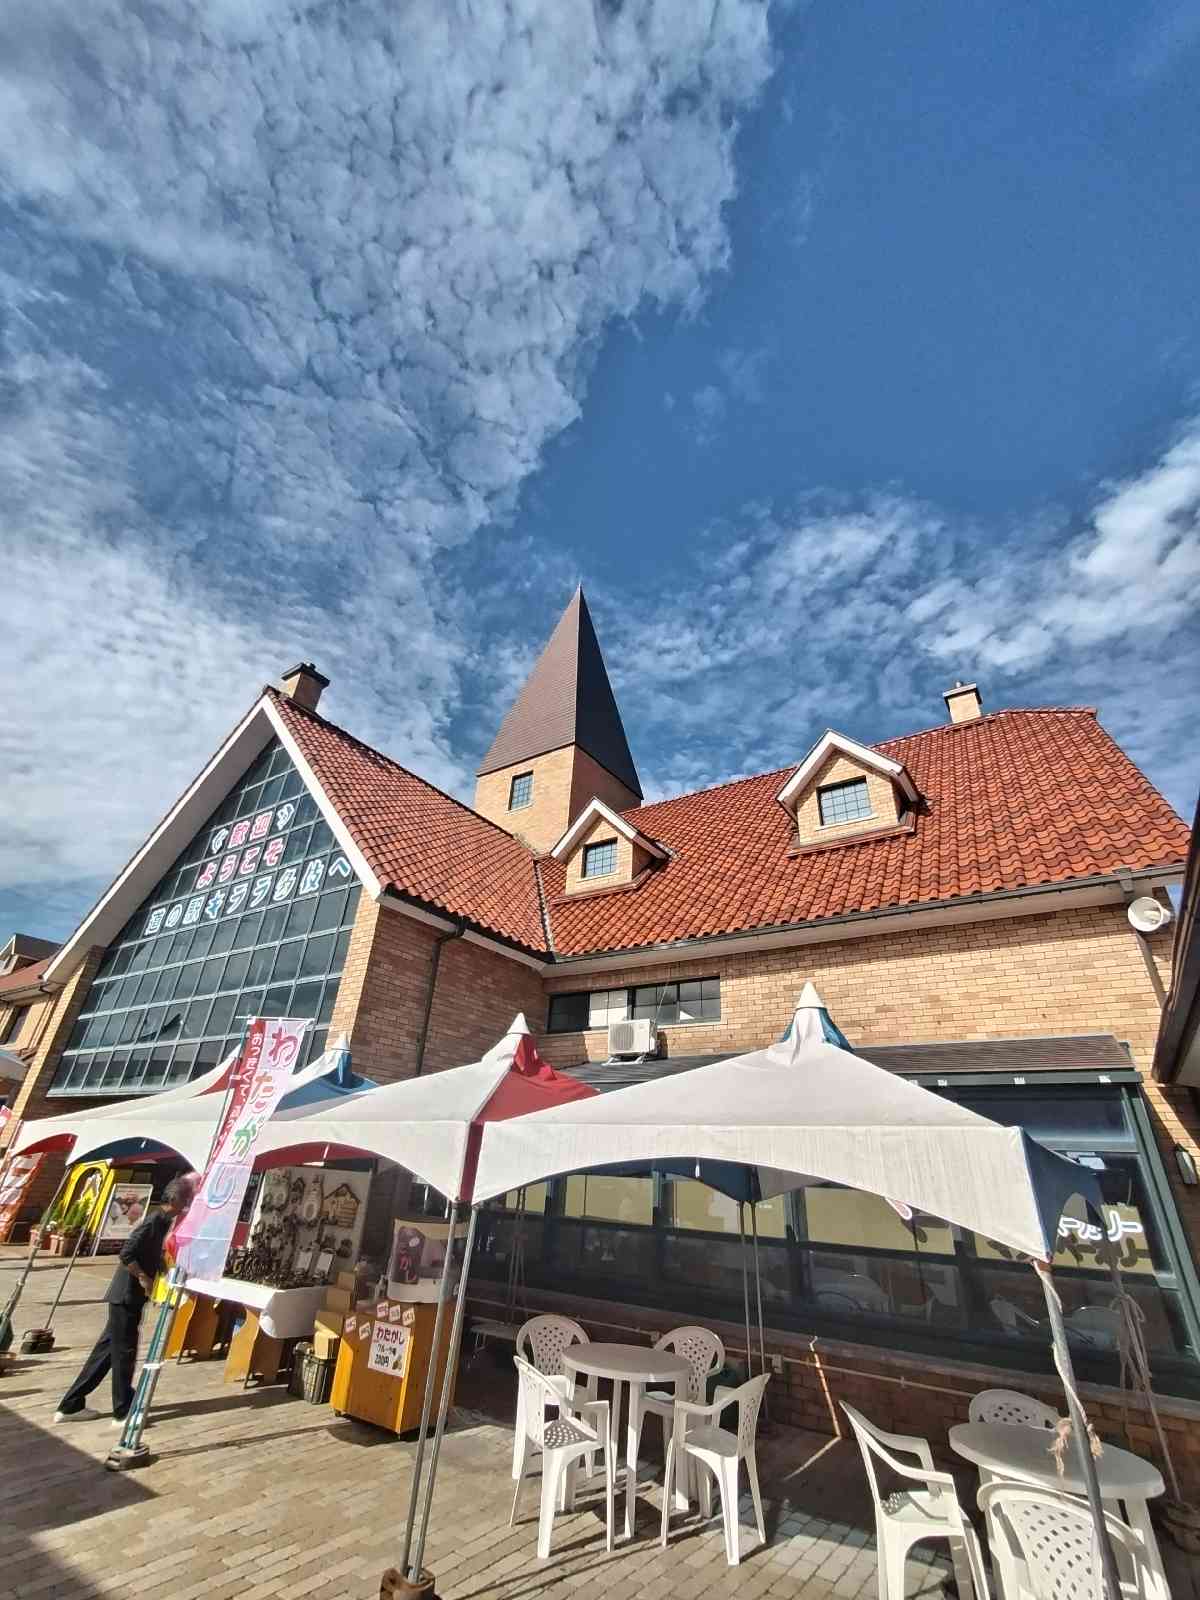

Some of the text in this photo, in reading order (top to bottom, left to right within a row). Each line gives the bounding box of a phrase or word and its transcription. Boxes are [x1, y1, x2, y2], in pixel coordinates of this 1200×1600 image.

[144, 856, 352, 937] 道の駅キララ多伎へ
[195, 837, 284, 890] ようこそ
[206, 1026, 300, 1209] わたがし
